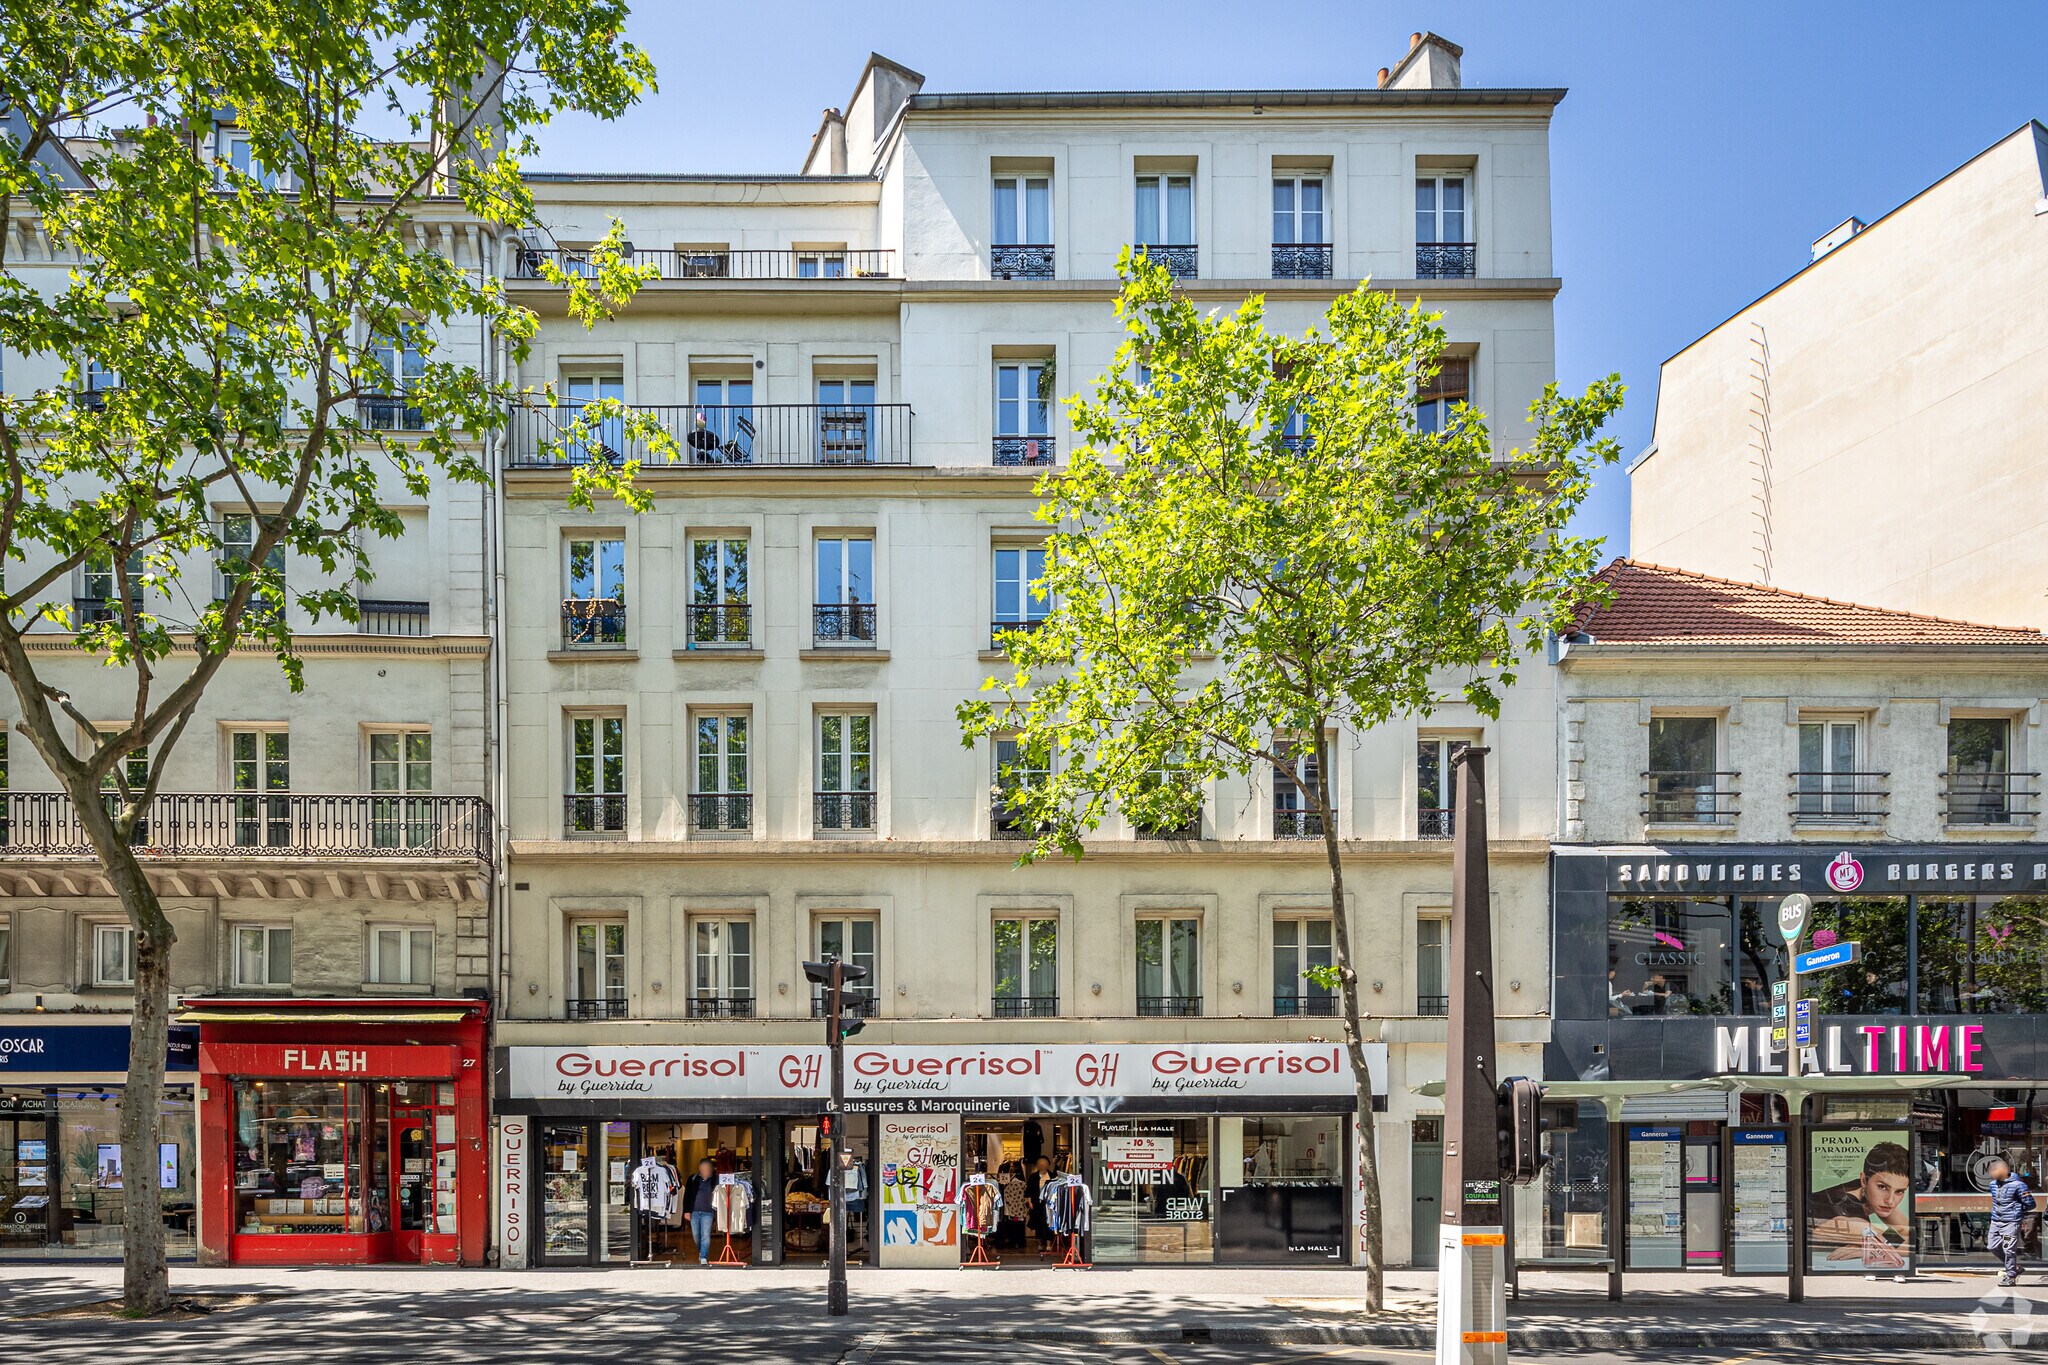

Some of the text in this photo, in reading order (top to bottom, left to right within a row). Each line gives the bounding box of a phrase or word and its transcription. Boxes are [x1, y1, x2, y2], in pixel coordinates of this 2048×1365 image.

[1618, 864, 1801, 882] SANDWICHES
[1839, 867, 1850, 877] MT
[1887, 863, 2014, 881] BURGERS
[1781, 903, 1802, 922] BUS
[1634, 952, 1706, 966] CLASSIC
[1806, 952, 1840, 966] Ganneron
[1775, 985, 1784, 994] 21
[1775, 1007, 1785, 1017] 54
[1775, 1029, 1784, 1038] 74
[0, 1039, 44, 1053] OSCAR
[463, 1059, 476, 1067] 27
[556, 1051, 744, 1077] Guerrisol
[853, 1050, 1041, 1076] Guerrisol
[1152, 1048, 1340, 1075] Guerrisol
[778, 1054, 823, 1089] GH
[1076, 1053, 1120, 1088] GH
[558, 1079, 653, 1093] by Guerrida
[853, 1078, 948, 1093] by Guerrida
[1152, 1076, 1247, 1091] by Guerrida
[826, 1099, 1010, 1113] Caussures & Maroquinerie
[886, 1122, 948, 1133] Guerrisol
[907, 1147, 934, 1164] GH
[1101, 1167, 1175, 1185] WOMEN
[504, 1124, 524, 1256] GUERRISOL
